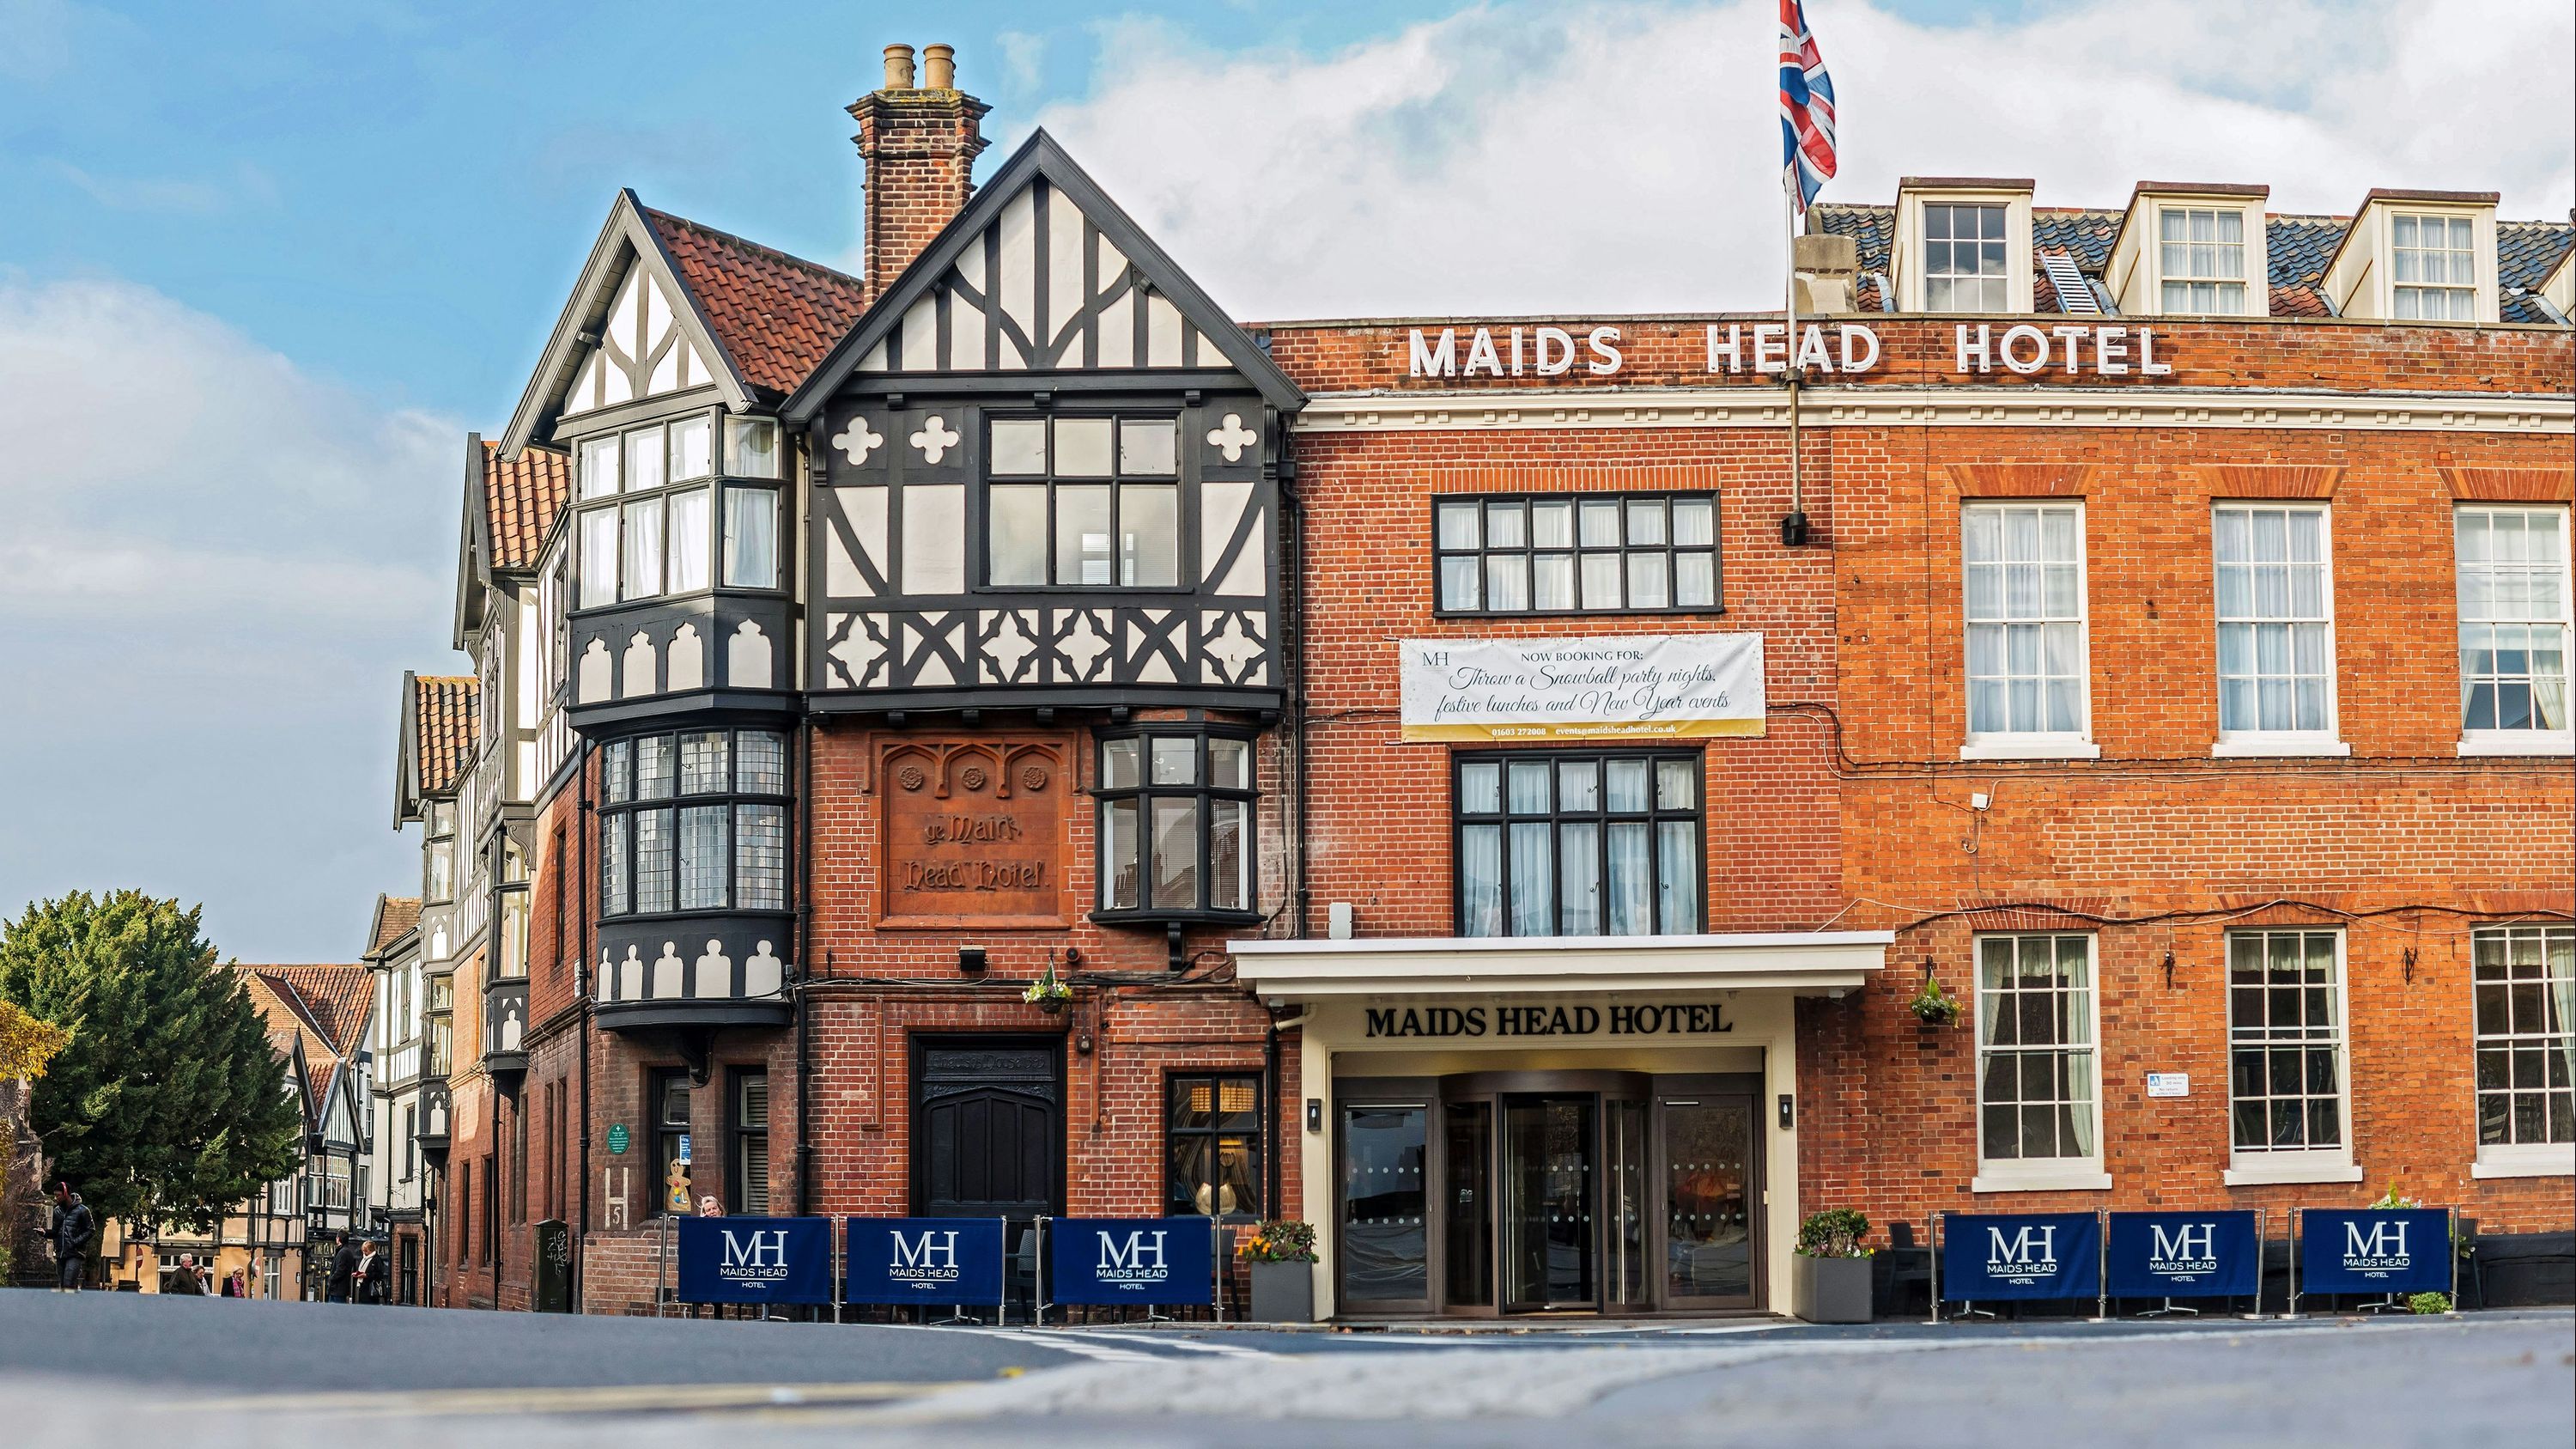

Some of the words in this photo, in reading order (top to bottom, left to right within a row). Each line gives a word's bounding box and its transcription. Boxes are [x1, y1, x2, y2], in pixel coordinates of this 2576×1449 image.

[1409, 326, 1623, 376] MAIDS
[1706, 324, 1880, 373] HEAD
[1955, 324, 2172, 374] HOTEL
[1422, 651, 1449, 667] MH
[1521, 652, 1552, 662] NOW
[1556, 650, 1613, 661] BOOKING
[1617, 650, 1643, 661] FOR:
[1449, 667, 1512, 690] Throw
[1515, 674, 1526, 686] a
[1529, 665, 1618, 691] Snowball
[1619, 665, 1664, 691] party
[1434, 694, 1481, 722] festive
[1486, 694, 1541, 712] lunches
[1546, 694, 1578, 712] and
[1580, 690, 1629, 716] New
[1633, 686, 1684, 721] Year
[1688, 690, 1732, 709] events
[1492, 728, 1516, 736] 01603
[1517, 728, 1546, 736] 272008
[1555, 725, 1676, 736] events@maidsheadhotel.co.uk
[1364, 1008, 1486, 1038] MAIDS
[1495, 1006, 1601, 1036] HEAD
[1608, 1003, 1734, 1034] HOTEL
[720, 1230, 789, 1267] MH
[890, 1230, 959, 1268] MH
[1096, 1230, 1168, 1269] MH
[1987, 1225, 2057, 1263] MH
[2149, 1223, 2217, 1262] MH
[2343, 1221, 2410, 1257] MH
[720, 1268, 756, 1277] MAIDS
[757, 1268, 788, 1277] HEAD
[889, 1269, 926, 1278] MAIDS
[927, 1269, 959, 1278] HEAD
[1096, 1269, 1133, 1279] MAIDS
[1134, 1269, 1169, 1279] HEAD
[1986, 1263, 2022, 1275] MAIDS
[2025, 1263, 2058, 1274] HEAD
[2149, 1262, 2184, 1271] MAIDS
[2186, 1261, 2217, 1270] HEAD
[2343, 1258, 2379, 1267] MAIDS
[2379, 1257, 2410, 1267] HEAD
